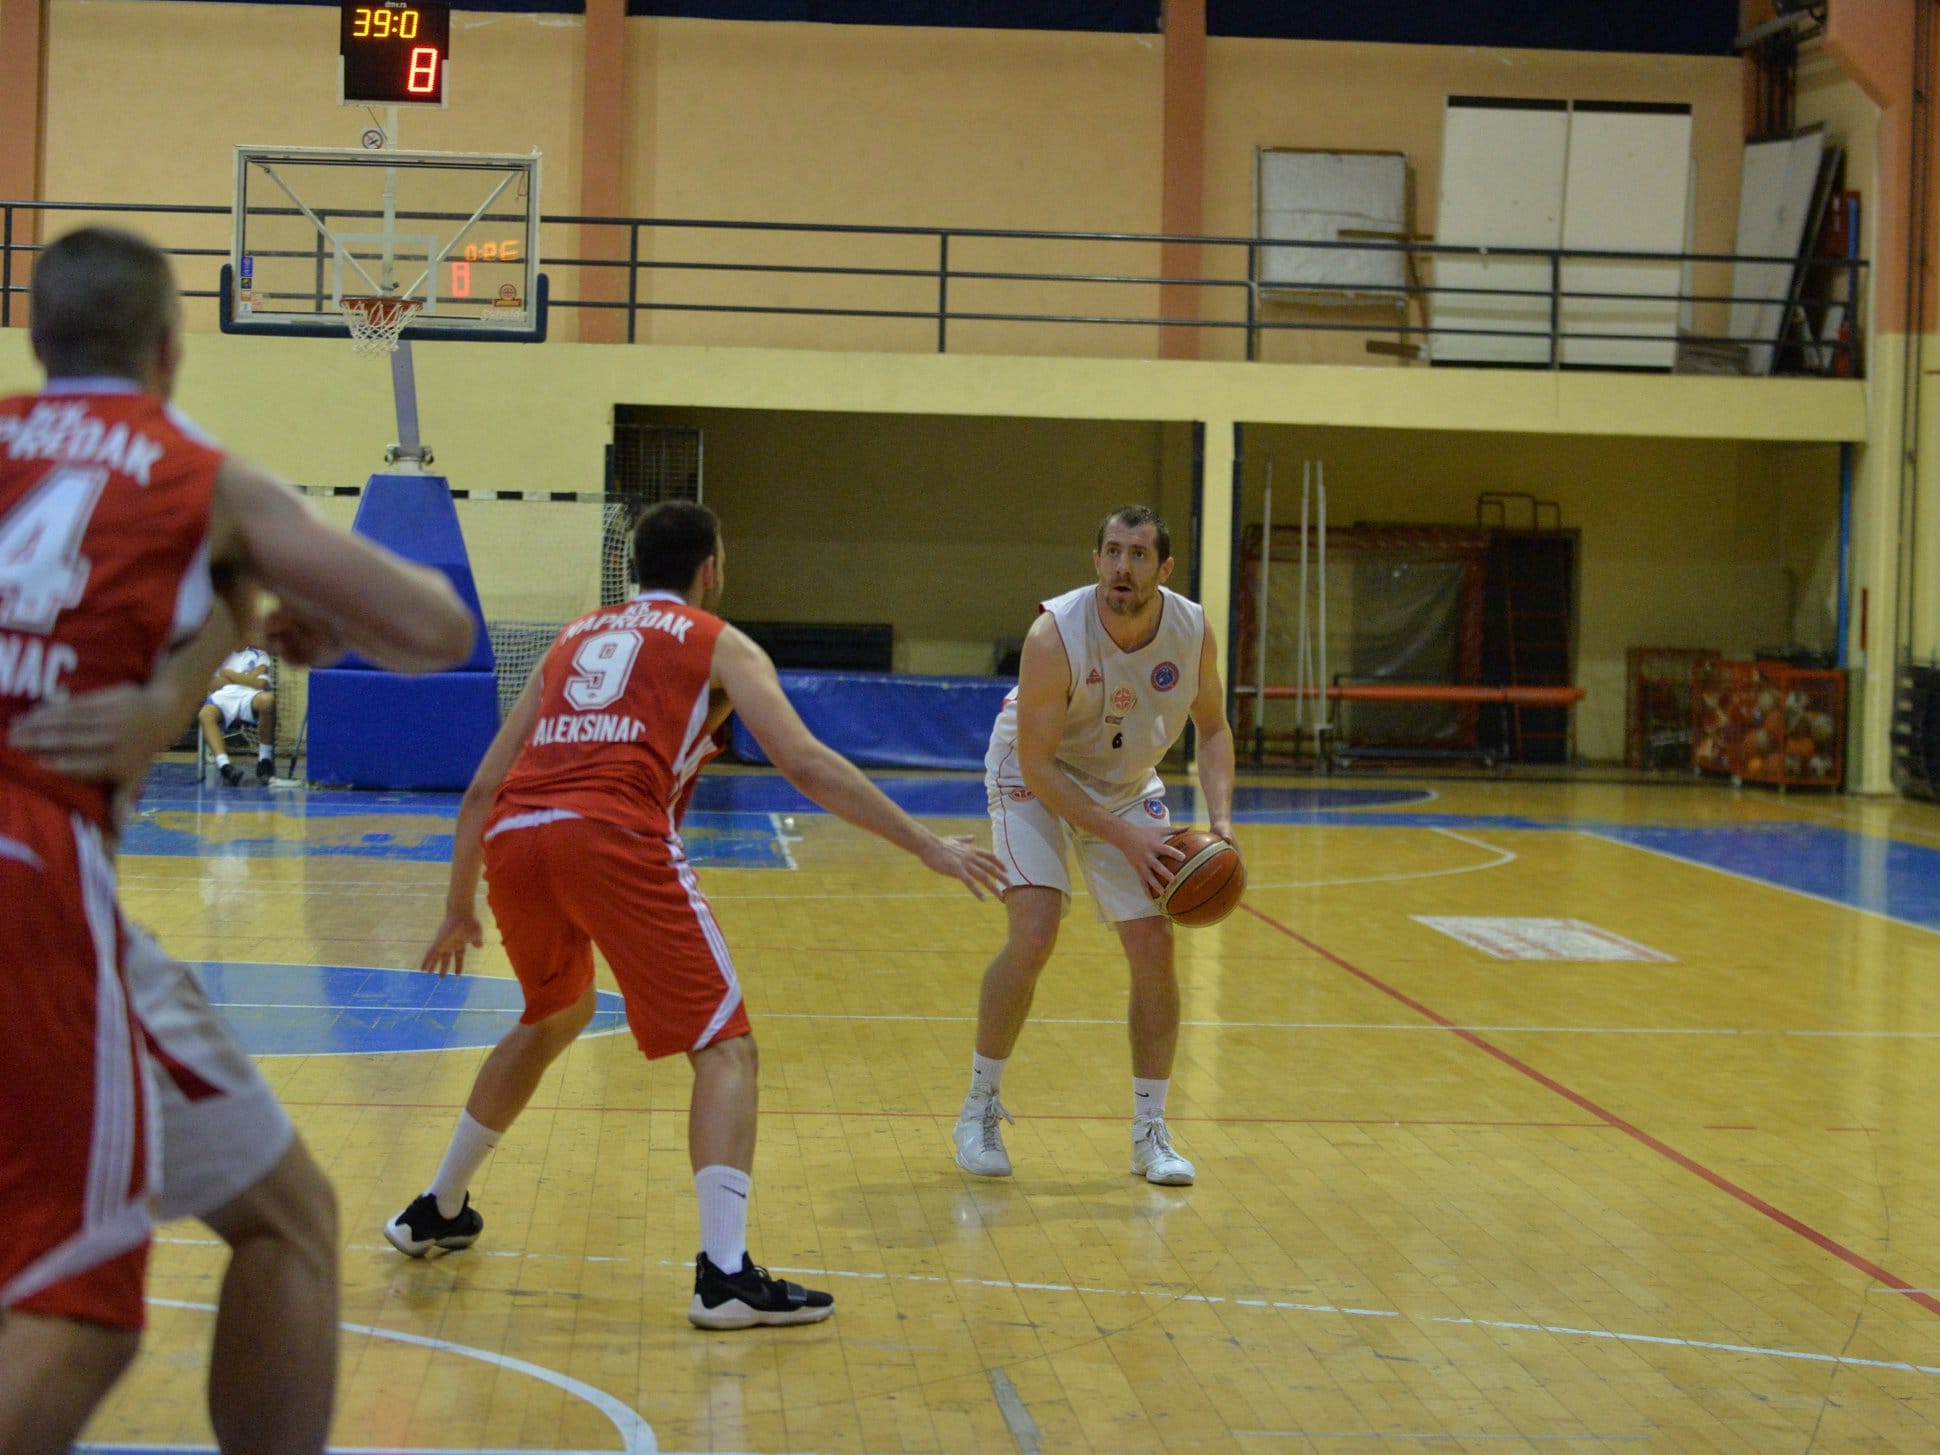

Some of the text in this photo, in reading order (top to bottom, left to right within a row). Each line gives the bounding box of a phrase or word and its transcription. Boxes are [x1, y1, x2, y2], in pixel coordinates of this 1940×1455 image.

[353, 8, 419, 39] 39:0
[407, 47, 438, 93] 8
[0, 465, 111, 635] 4
[563, 629, 644, 711] 9
[1112, 732, 1123, 750] 6
